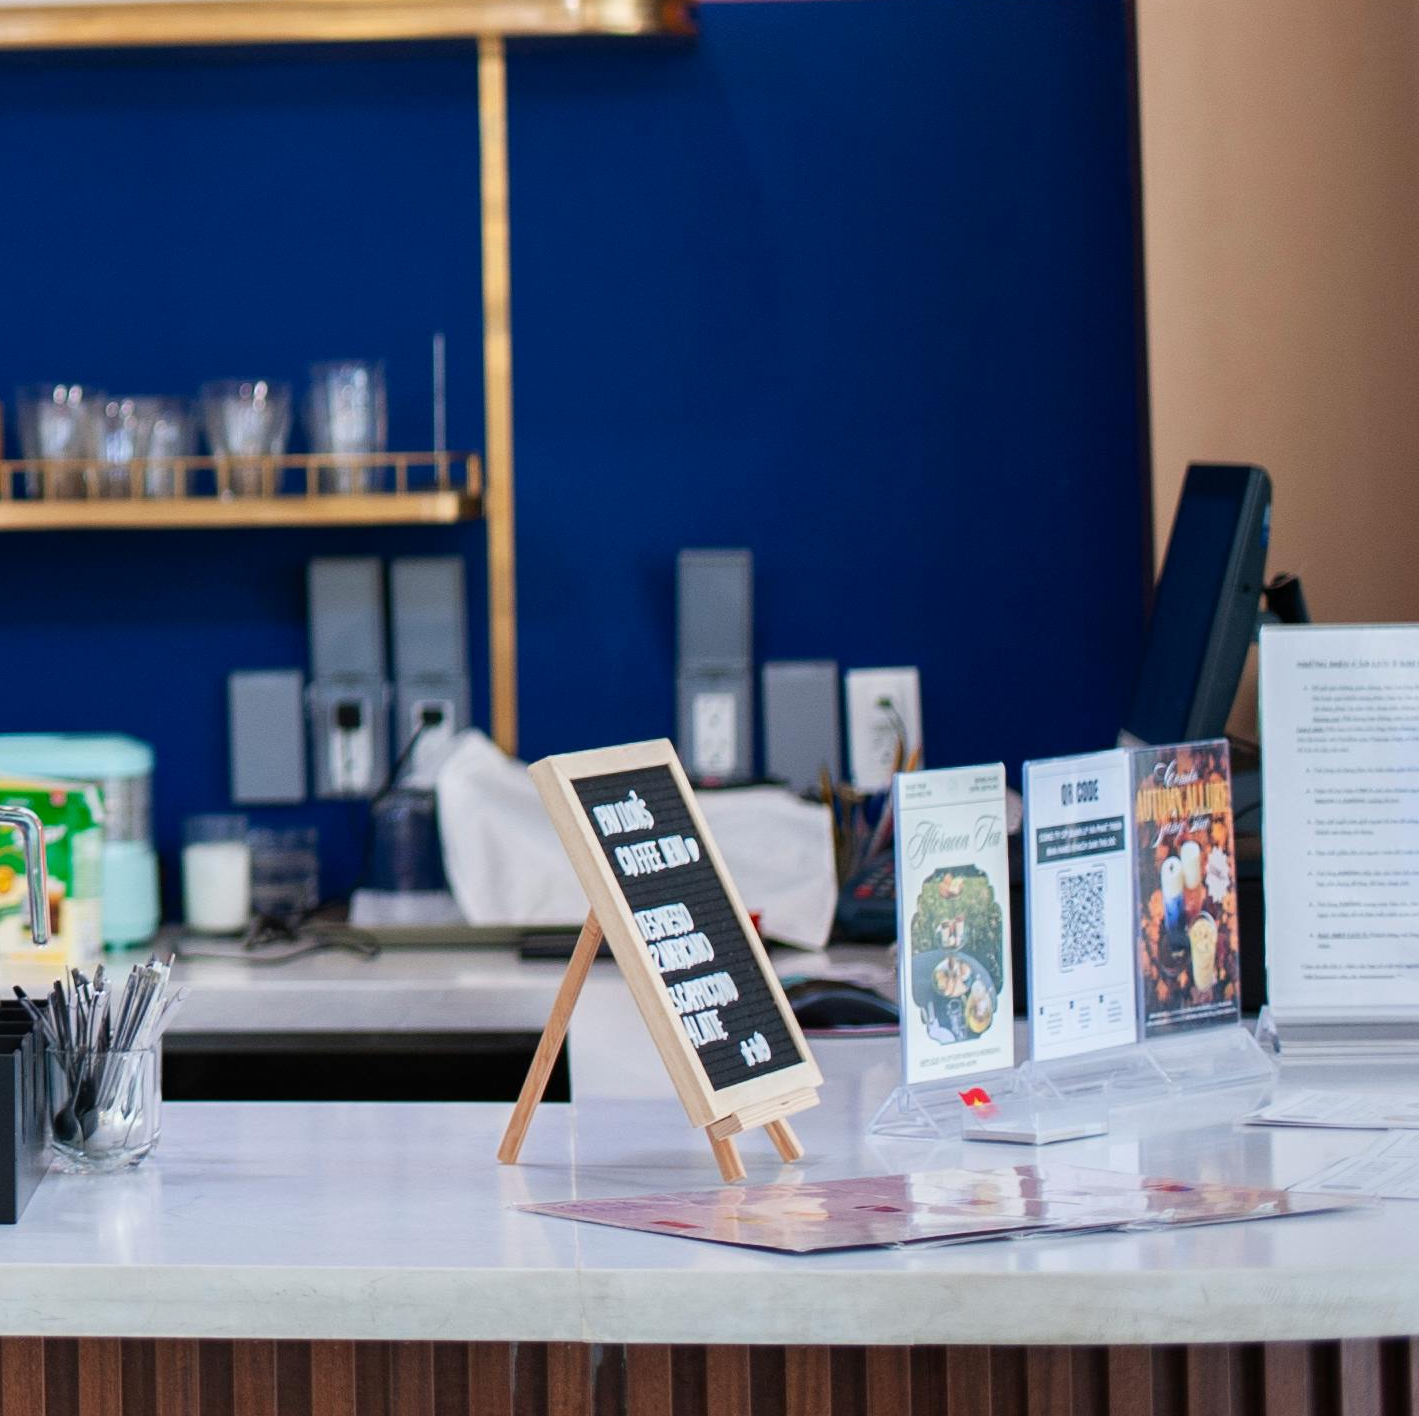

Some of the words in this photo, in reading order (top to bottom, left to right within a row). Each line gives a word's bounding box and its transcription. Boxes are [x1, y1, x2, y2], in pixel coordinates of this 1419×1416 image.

[1077, 779, 1099, 803] CODE
[907, 820, 970, 870] Afternoon
[974, 815, 1002, 853] Tea
